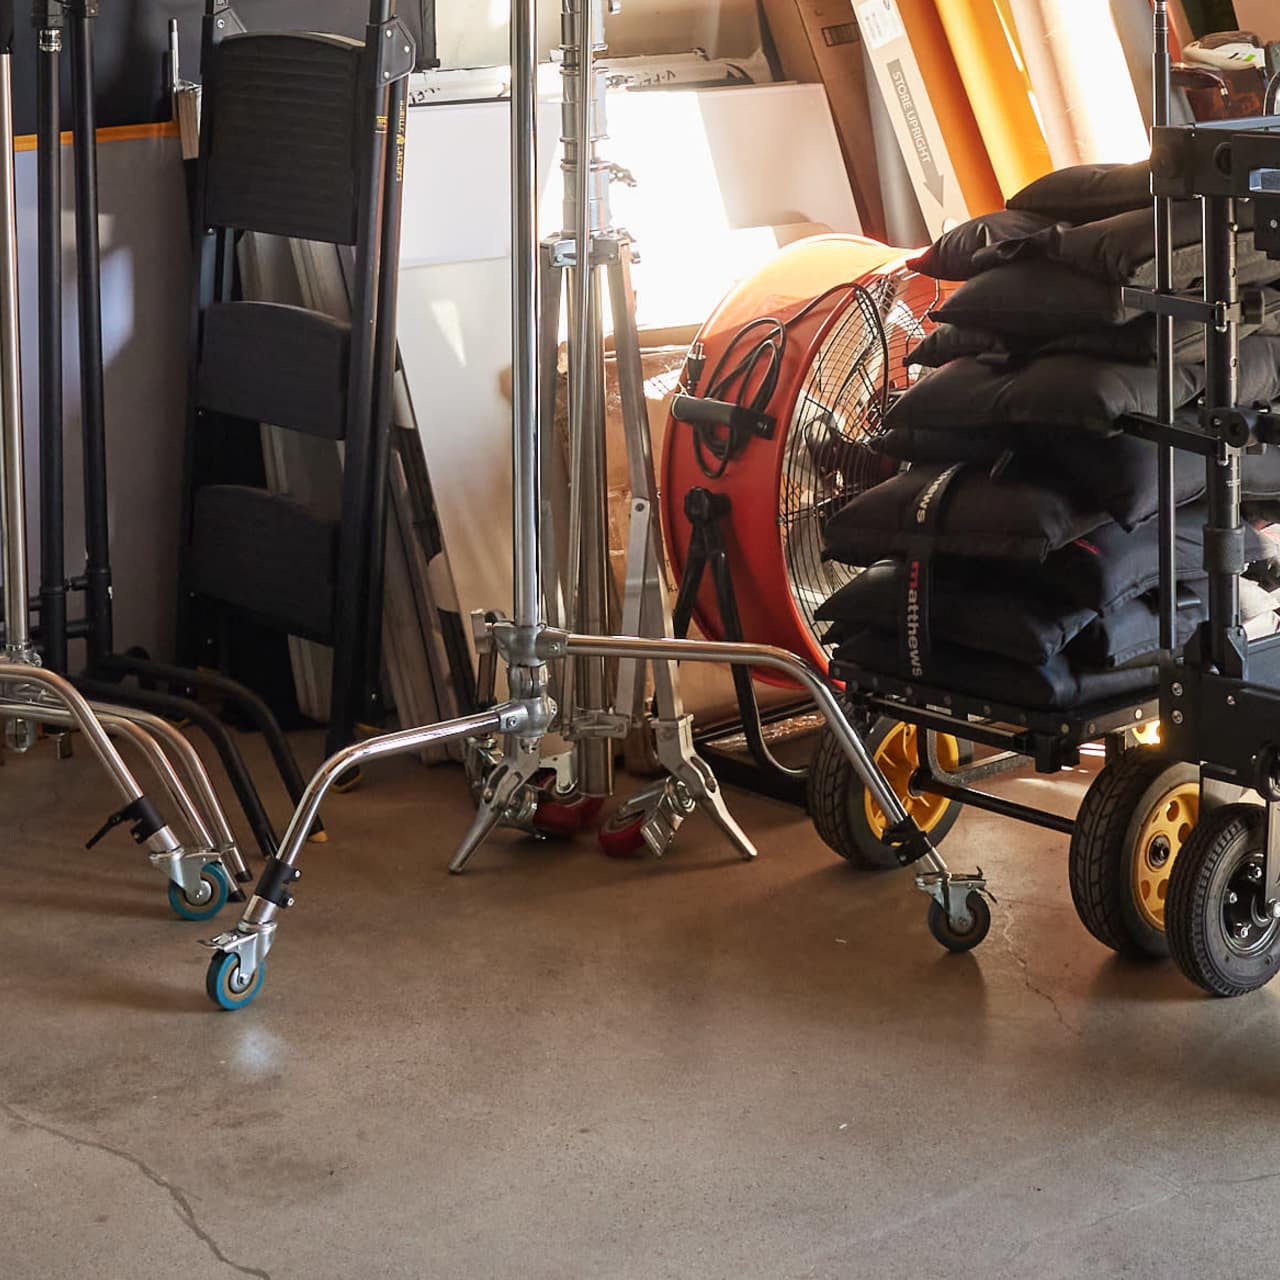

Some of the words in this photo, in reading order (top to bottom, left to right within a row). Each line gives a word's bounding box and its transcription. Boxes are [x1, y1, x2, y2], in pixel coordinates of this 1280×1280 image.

[892, 71, 913, 110] STORE
[903, 110, 932, 163] UPRIGHT
[906, 560, 923, 677] matthews
